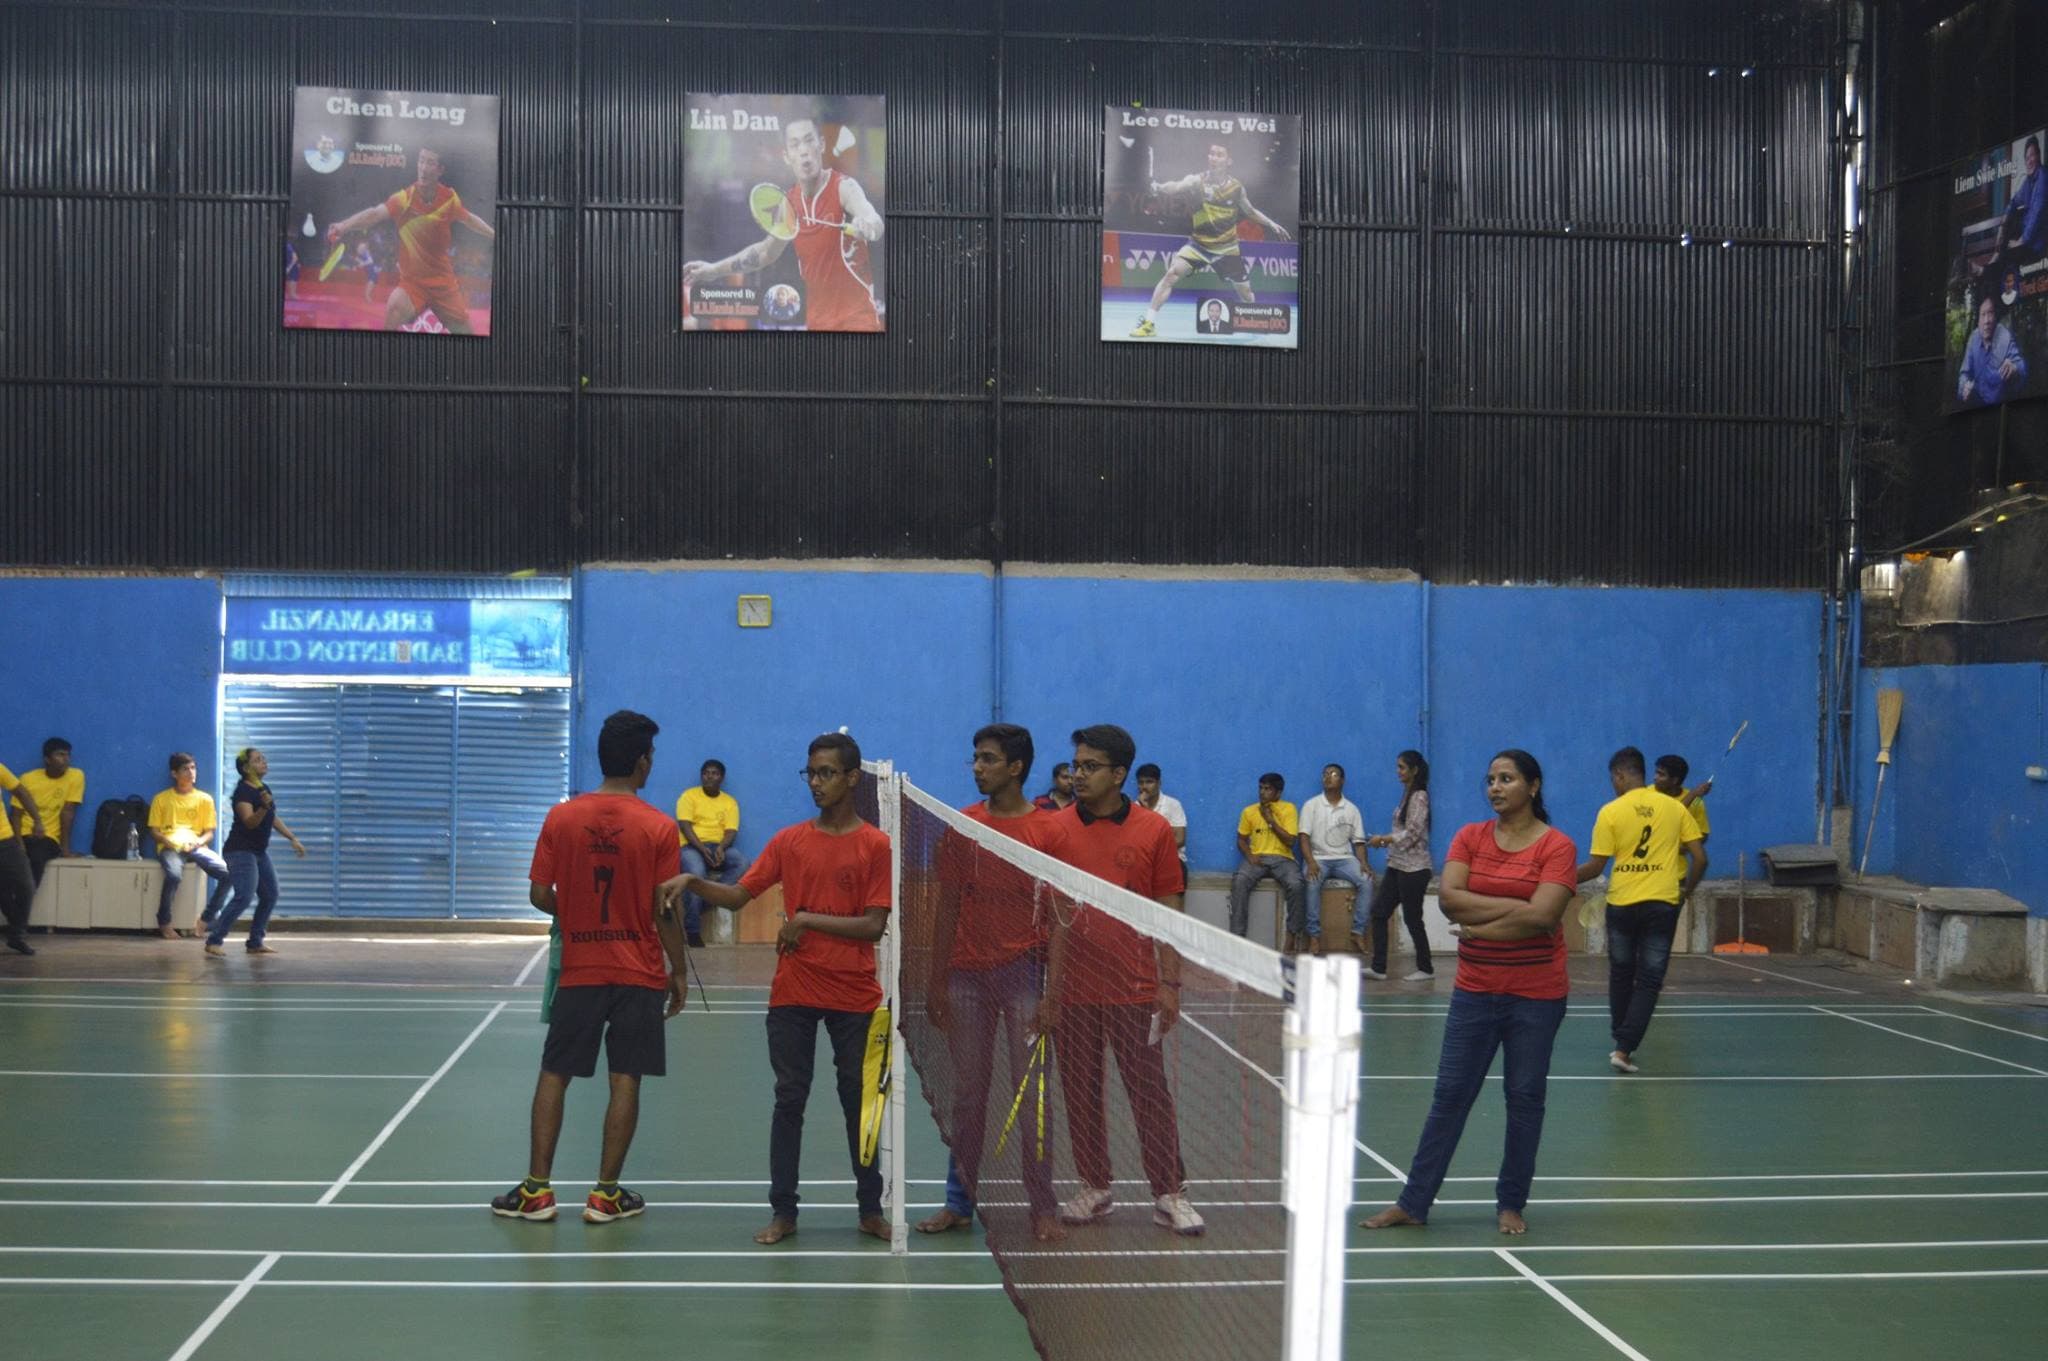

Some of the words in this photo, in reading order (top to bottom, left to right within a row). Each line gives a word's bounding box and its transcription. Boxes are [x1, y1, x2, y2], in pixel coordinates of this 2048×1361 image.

[326, 97, 393, 116] Chen
[400, 101, 466, 126] Long
[690, 108, 728, 130] Lin
[732, 109, 780, 131] Dan
[1122, 112, 1160, 127] Lee
[1164, 114, 1234, 134] Chong
[1238, 117, 1276, 133] Wei
[1998, 160, 2017, 177] King
[700, 288, 744, 300] Sponsored
[1633, 824, 1652, 859] 2
[593, 865, 614, 924] 7
